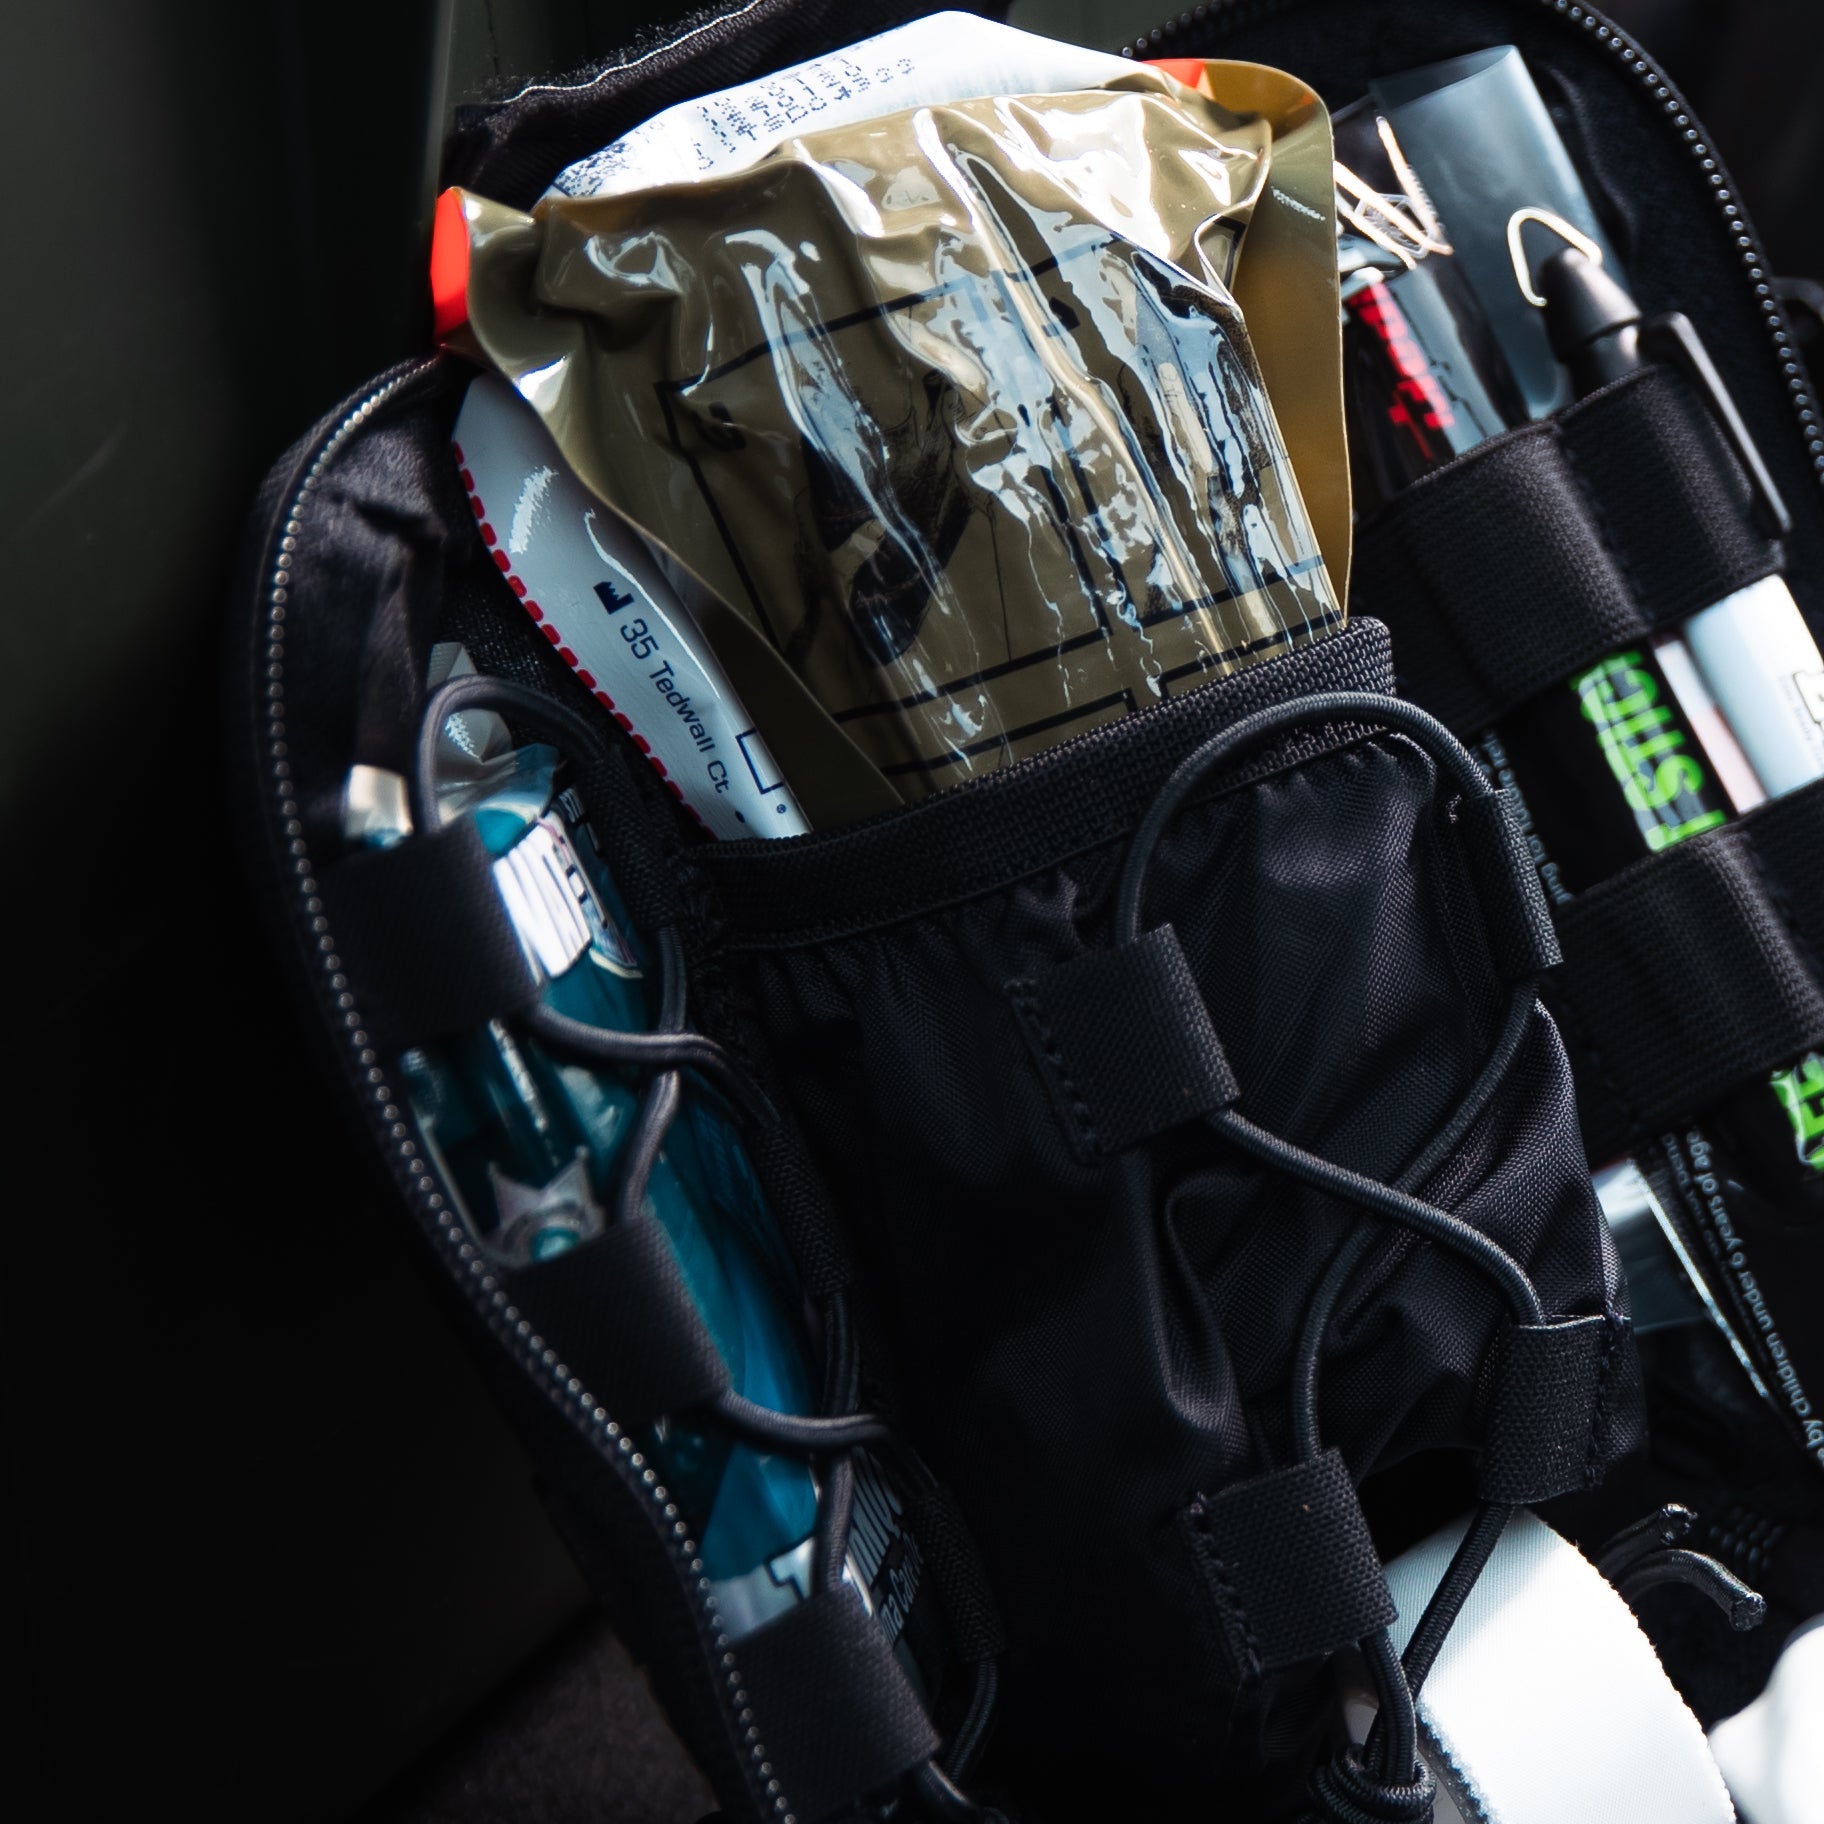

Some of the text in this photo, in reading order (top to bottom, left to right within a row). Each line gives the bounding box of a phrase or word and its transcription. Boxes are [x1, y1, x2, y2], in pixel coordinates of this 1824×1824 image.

[620, 618, 729, 794] 35 Tedwall Ct
[1694, 1172, 1718, 1195] of
[1708, 1195, 1743, 1252] years
[1730, 1251, 1746, 1269] 6
[1737, 1270, 1775, 1332] under
[1766, 1332, 1811, 1417] children
